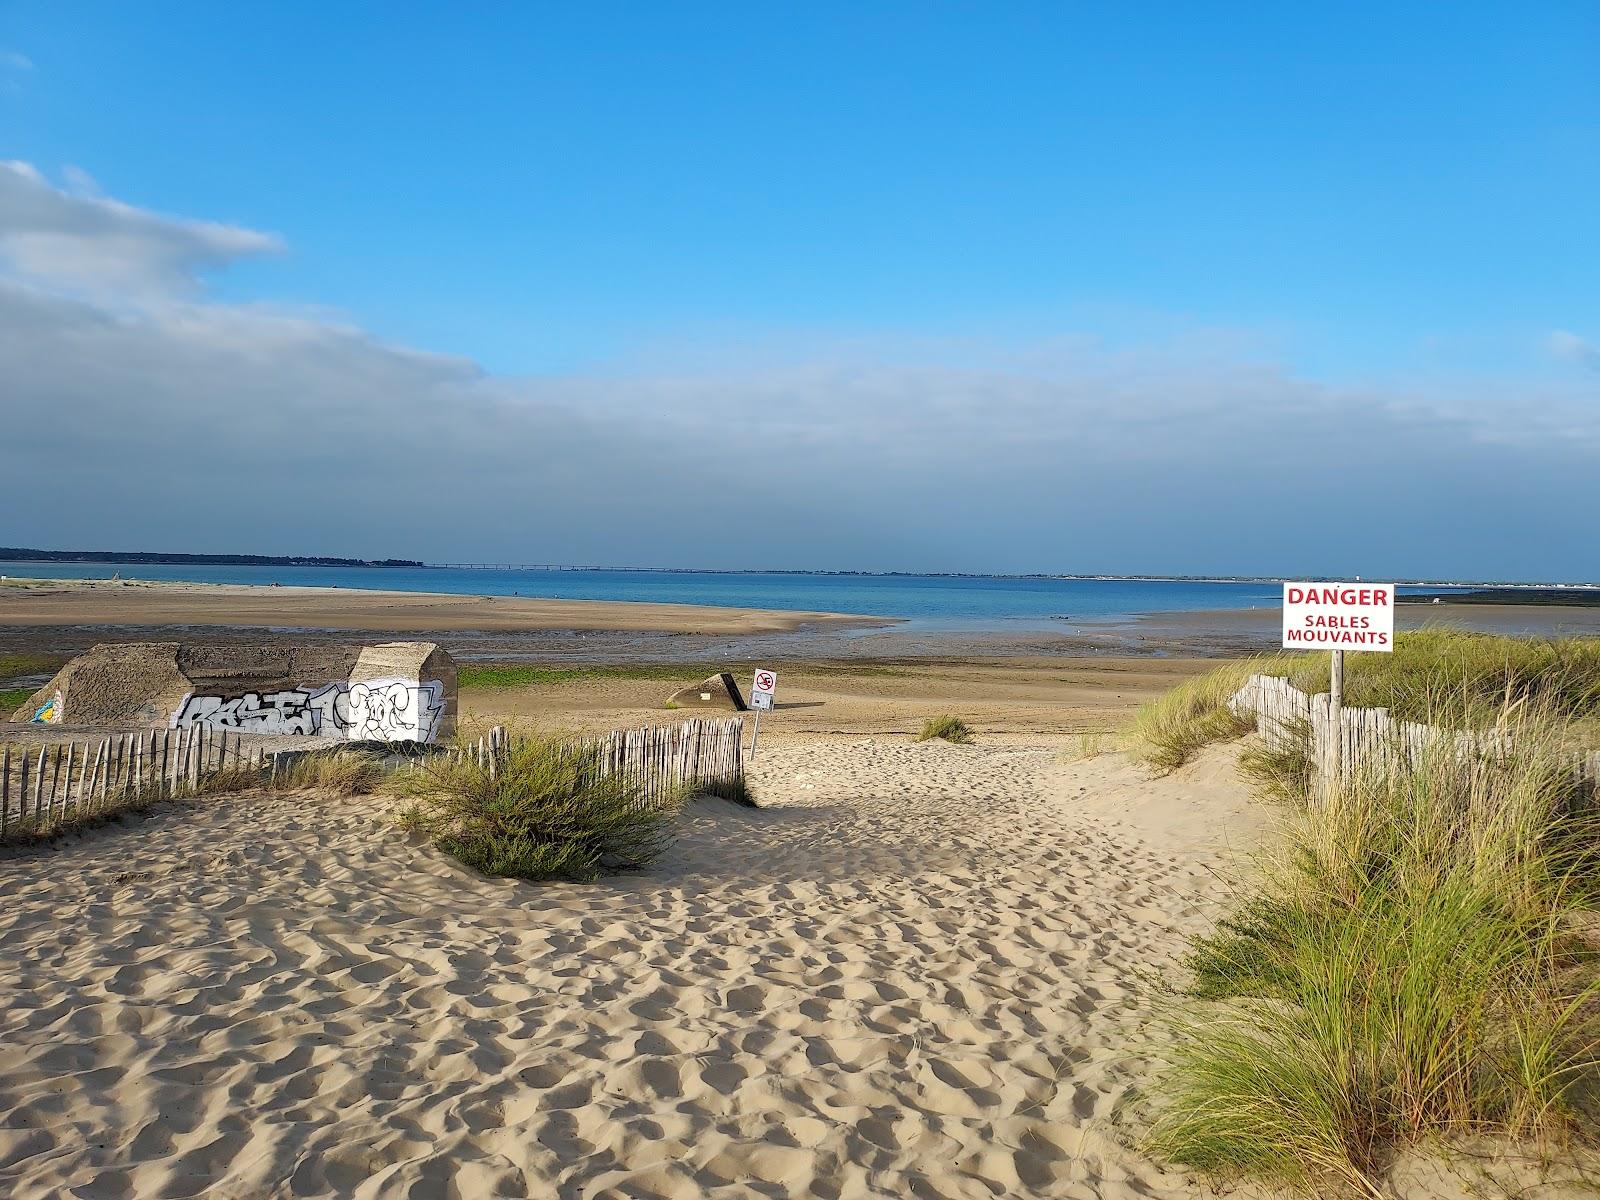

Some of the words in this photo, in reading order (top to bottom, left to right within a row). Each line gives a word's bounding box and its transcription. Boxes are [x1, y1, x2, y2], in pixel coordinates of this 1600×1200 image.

[1288, 588, 1388, 606] DANGER
[1305, 615, 1370, 629] SABLES
[1287, 630, 1388, 645] MOUVANTS
